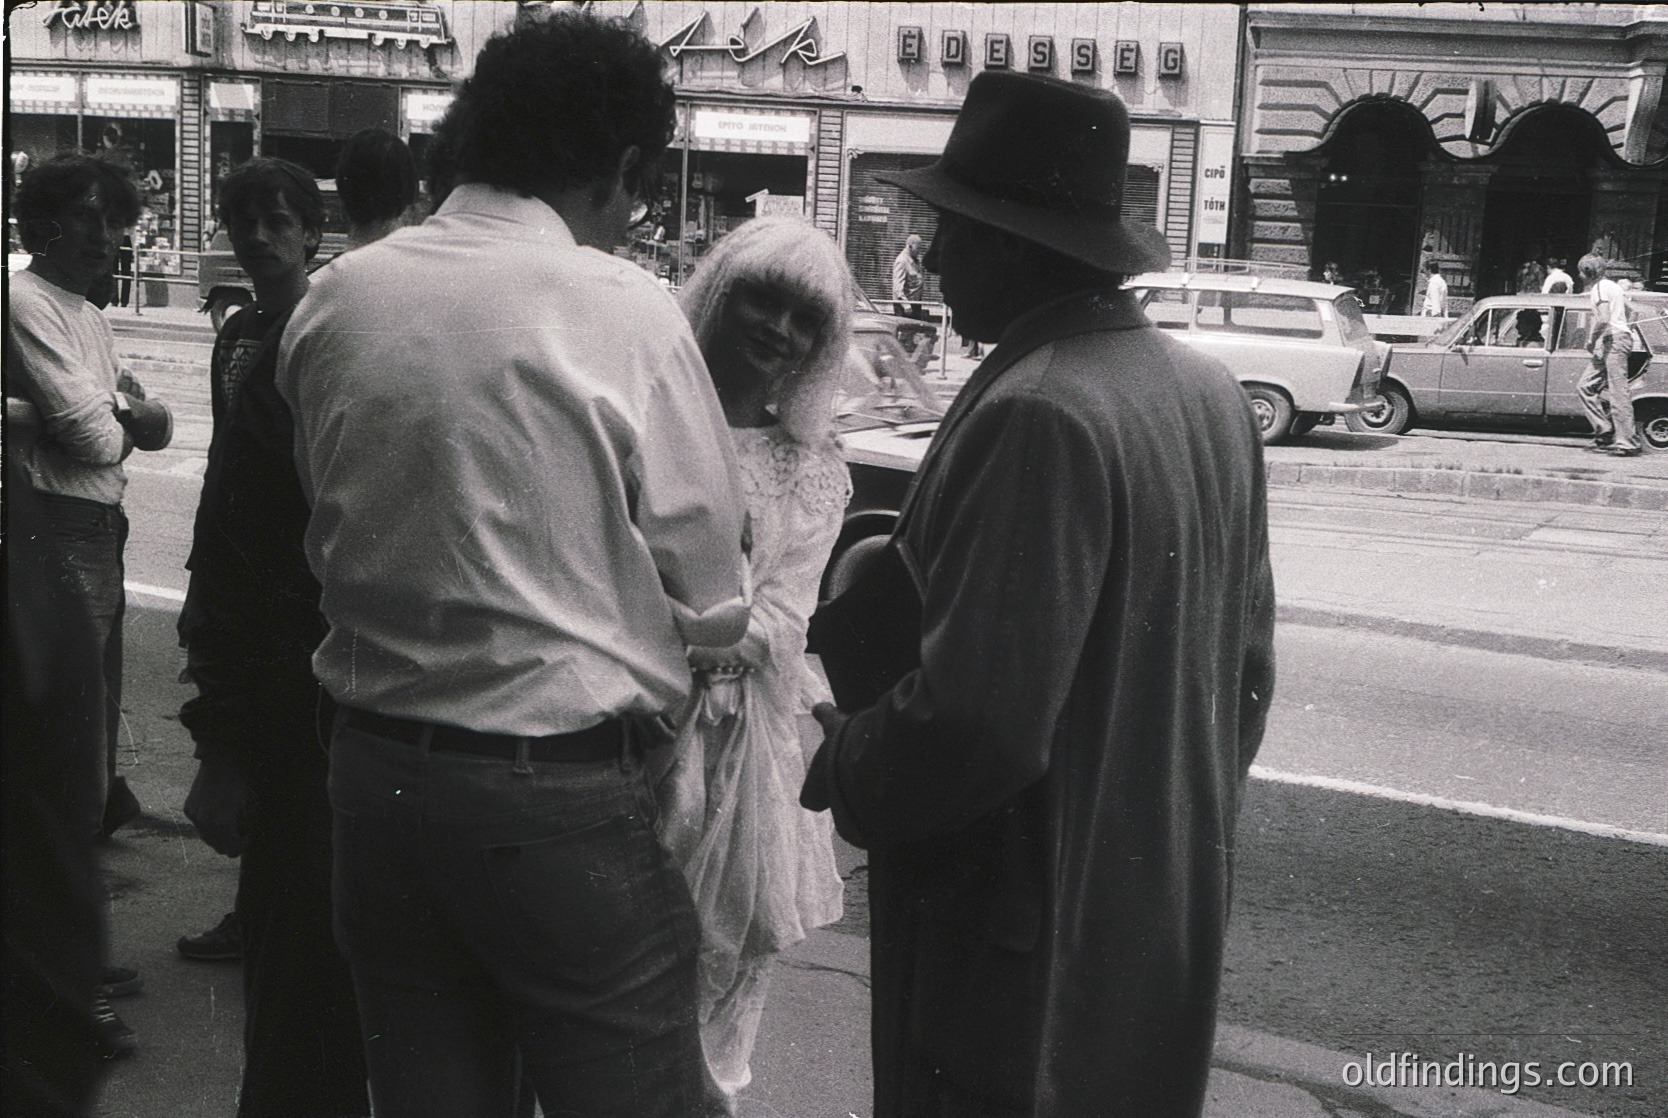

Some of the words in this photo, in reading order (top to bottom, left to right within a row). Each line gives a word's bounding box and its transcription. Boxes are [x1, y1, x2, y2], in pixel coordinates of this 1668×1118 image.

[899, 28, 1181, 72] ÉDESSÉG
[1203, 165, 1226, 179] CIPŐ
[1203, 196, 1226, 211] TÓTH
